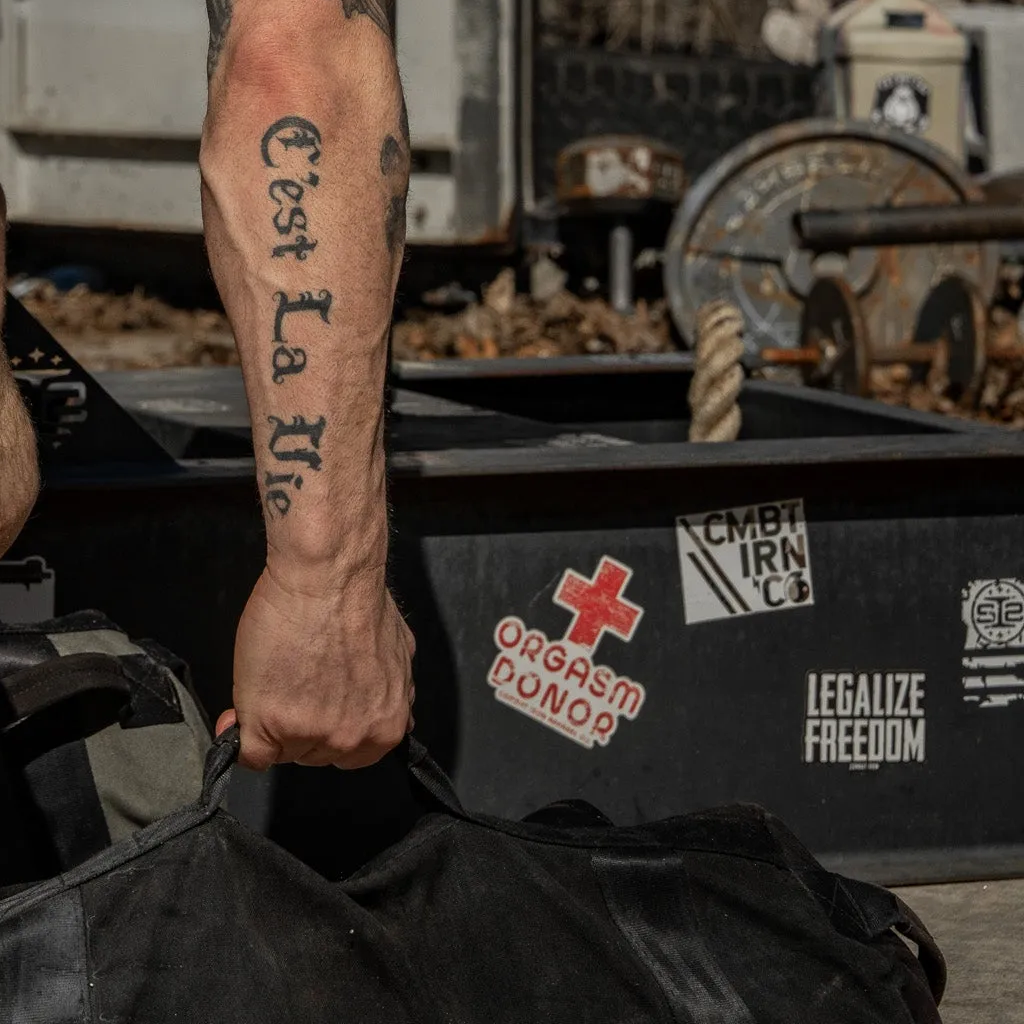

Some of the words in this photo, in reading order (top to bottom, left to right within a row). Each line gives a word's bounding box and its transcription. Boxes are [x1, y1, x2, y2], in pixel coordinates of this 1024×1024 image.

[271, 289, 332, 385] La
[703, 501, 800, 545] CMBT
[739, 534, 806, 578] IRN
[498, 621, 641, 714] ORGASM
[491, 656, 615, 741] DONOR
[807, 672, 926, 717] LEGALIZE
[805, 717, 926, 763] FREEDOM
